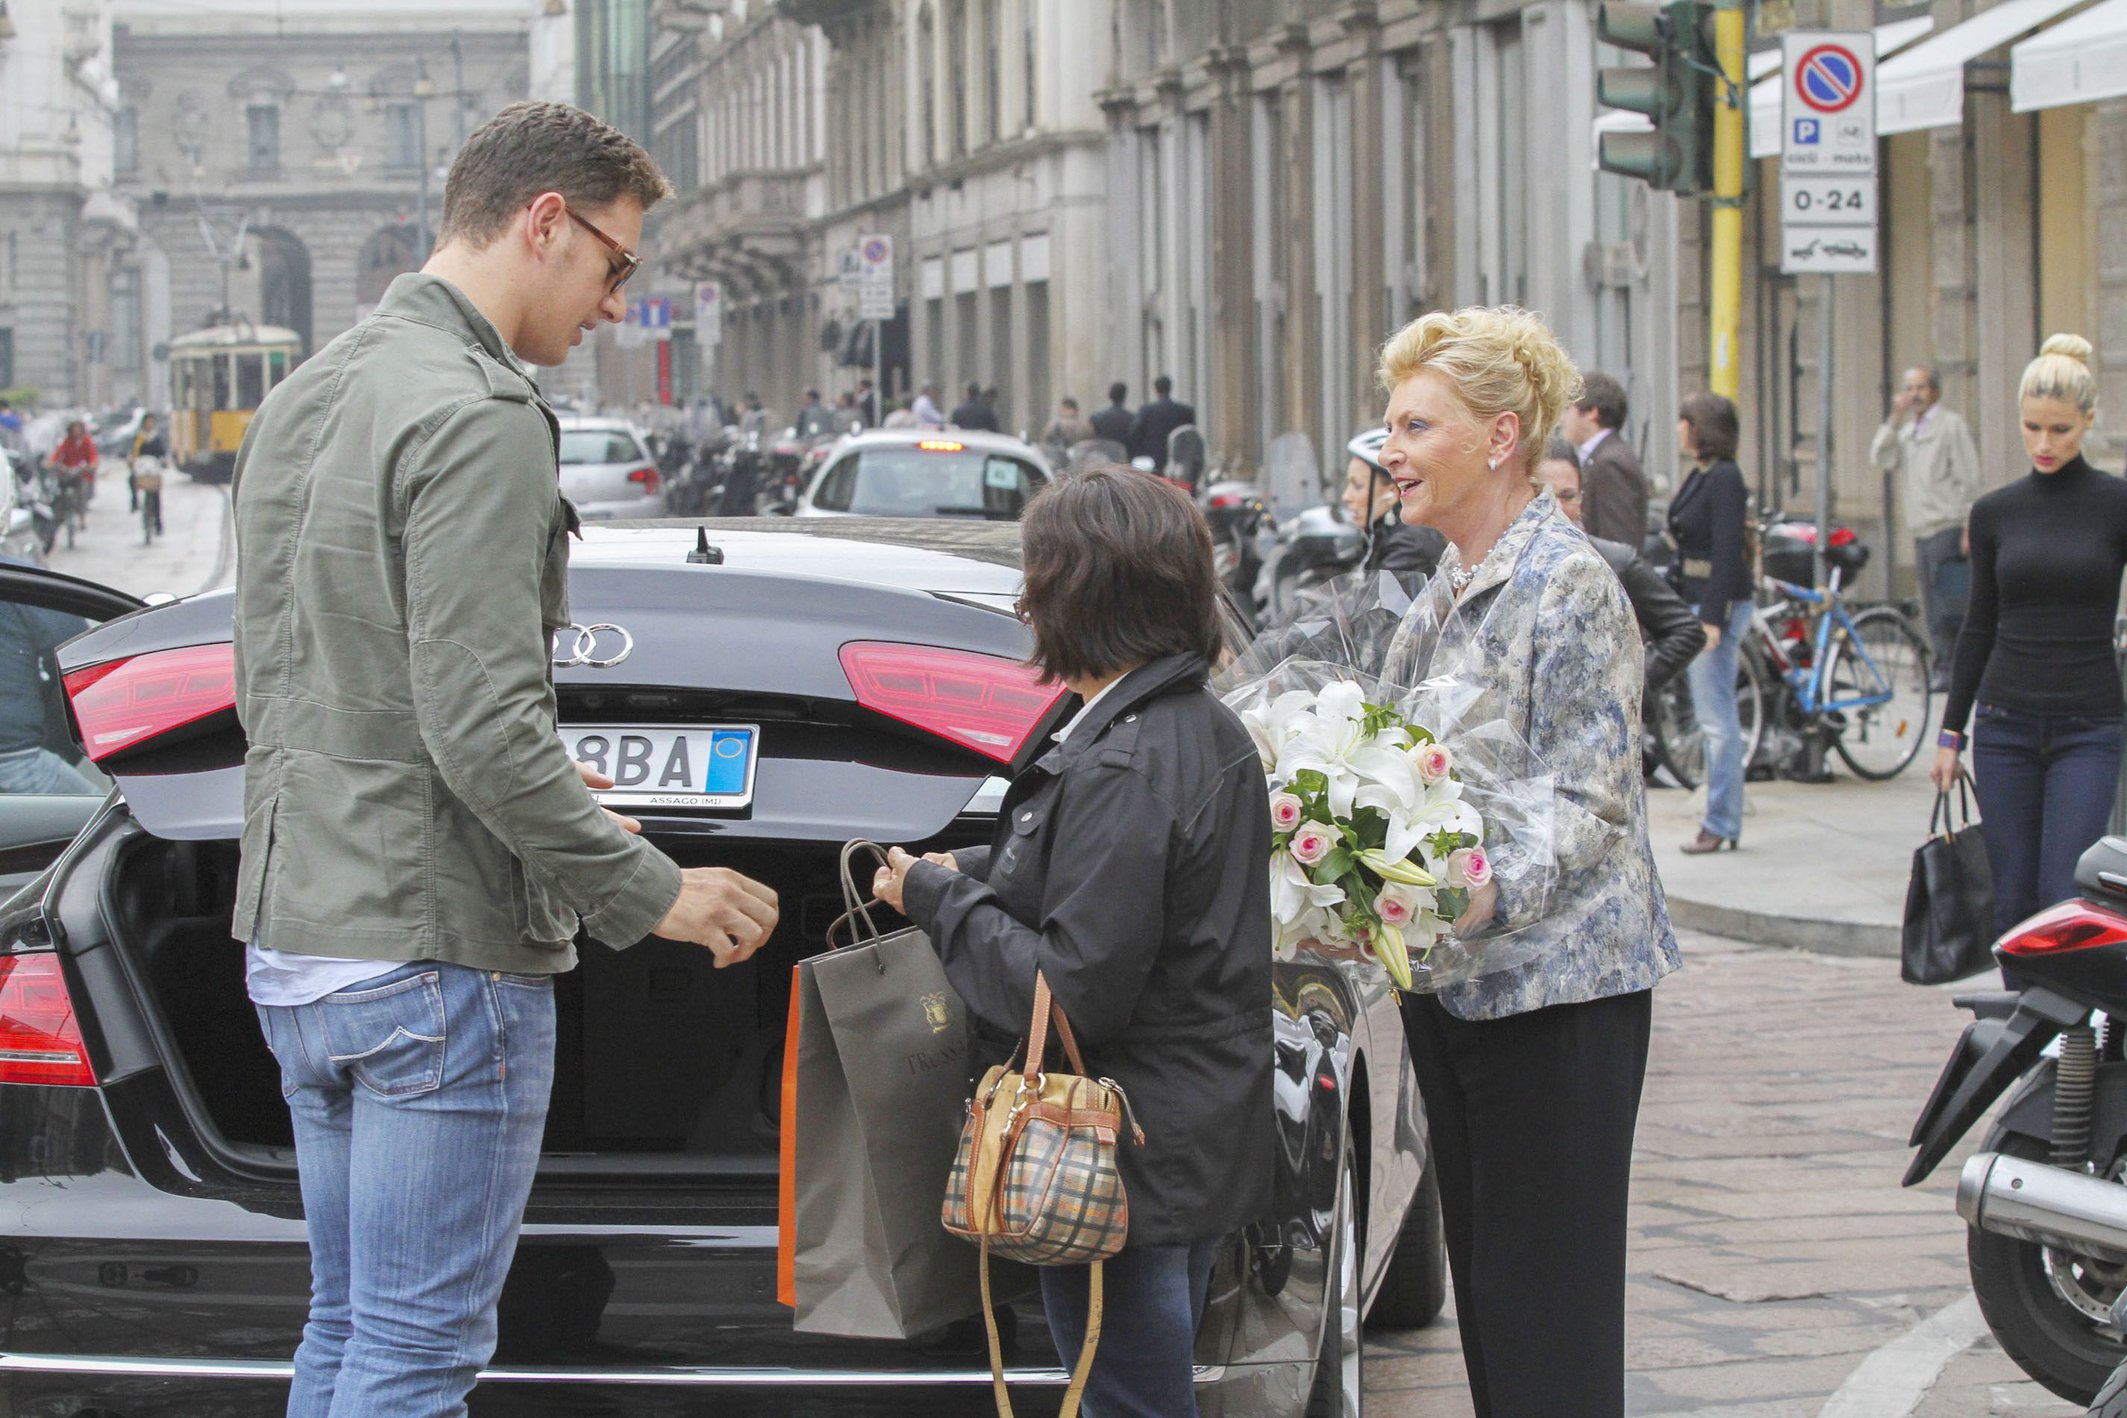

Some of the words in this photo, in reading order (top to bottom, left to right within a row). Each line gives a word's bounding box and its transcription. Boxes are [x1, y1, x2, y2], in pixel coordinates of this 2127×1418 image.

[1799, 122, 1815, 140] P
[649, 797, 698, 805] ASSAGO
[701, 798, 722, 806] (MI)
